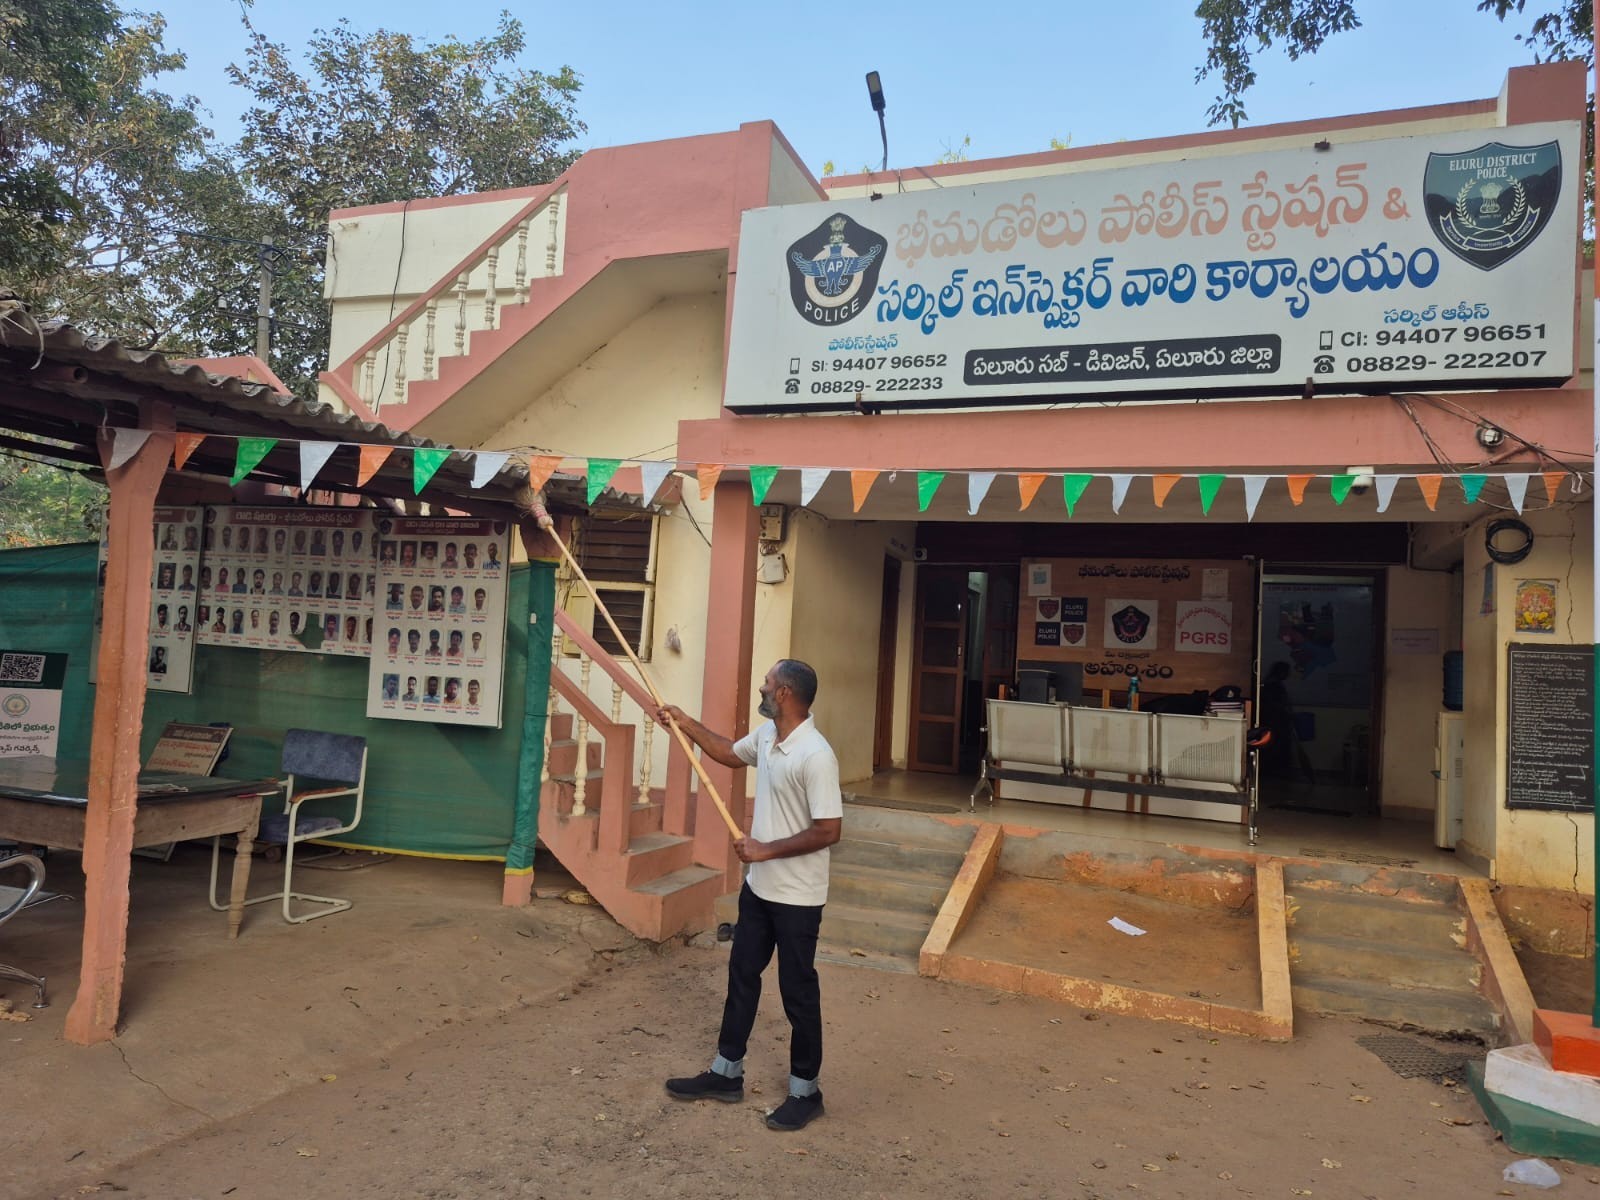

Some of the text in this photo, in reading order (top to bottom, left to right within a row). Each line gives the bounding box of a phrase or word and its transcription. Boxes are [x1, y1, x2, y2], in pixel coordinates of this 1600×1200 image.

[1449, 153, 1537, 171] ELURU DISTRICT
[1477, 167, 1508, 179] POLICE
[895, 162, 1412, 268] భీమడోలు పోలీస్ స్టేషన్ &
[827, 260, 843, 273] AP
[877, 269, 968, 335] సర్కిల్
[1121, 262, 1197, 307] వారి
[1205, 242, 1440, 319] కార్యాలయం
[804, 297, 860, 323] POLICE
[1384, 301, 1490, 327] సర్కిల్ ఆఫీస్
[1341, 323, 1547, 347] CI: 94407 96651
[811, 354, 947, 372] SI: 94407 96652
[973, 356, 1035, 376] ఏలూరు
[1038, 351, 1070, 374] సబ్
[1086, 347, 1150, 373] డివిజన్,
[1156, 347, 1225, 369] ఏలూరు
[1231, 346, 1273, 370] జిల్లా
[1444, 351, 1548, 370] 222207
[876, 377, 943, 392] 222233
[1180, 632, 1228, 645] PGRS
